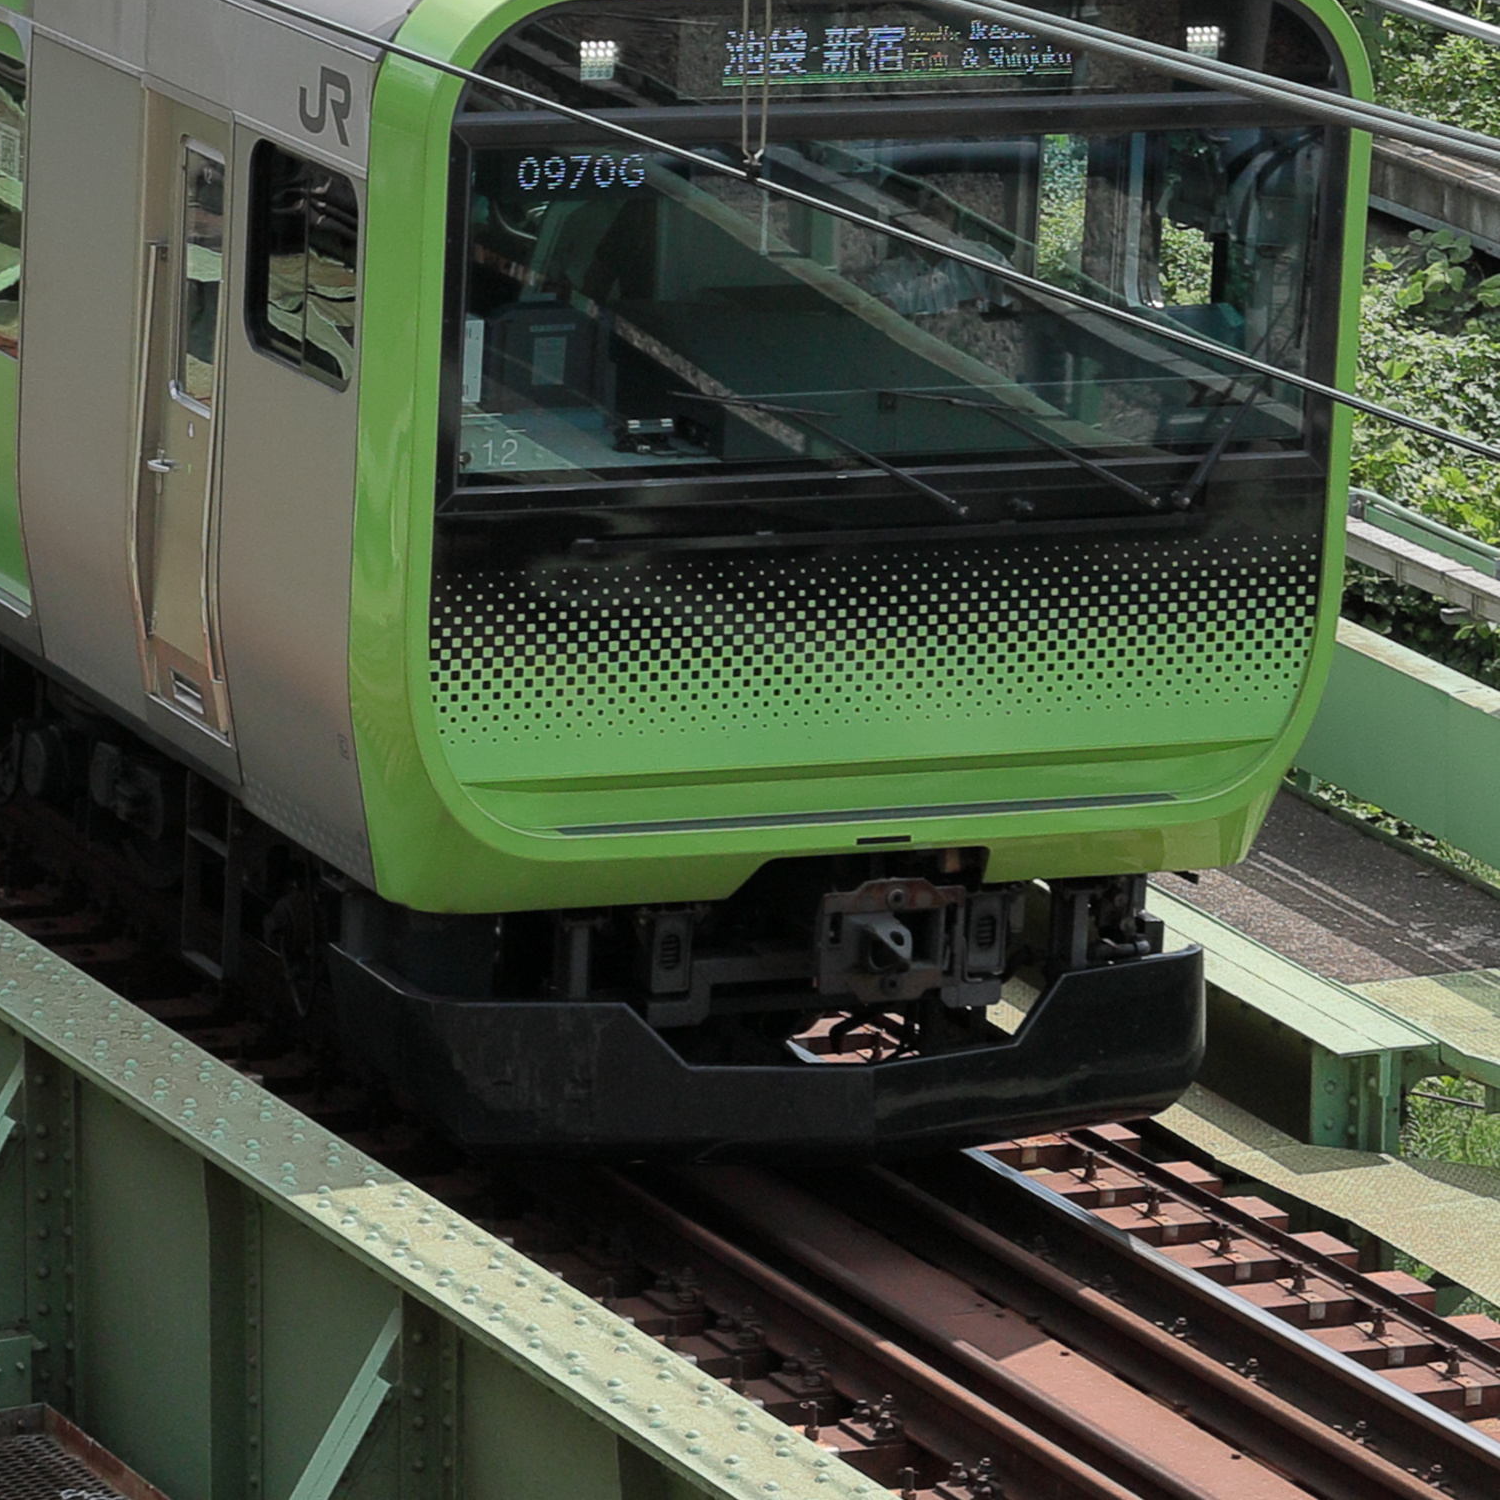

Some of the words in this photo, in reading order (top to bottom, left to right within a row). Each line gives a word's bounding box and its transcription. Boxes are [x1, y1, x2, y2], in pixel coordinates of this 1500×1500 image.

[988, 45, 1072, 72] Shinjuku
[299, 65, 352, 148] JR
[518, 153, 646, 191] 0970G
[482, 438, 519, 467] 12
